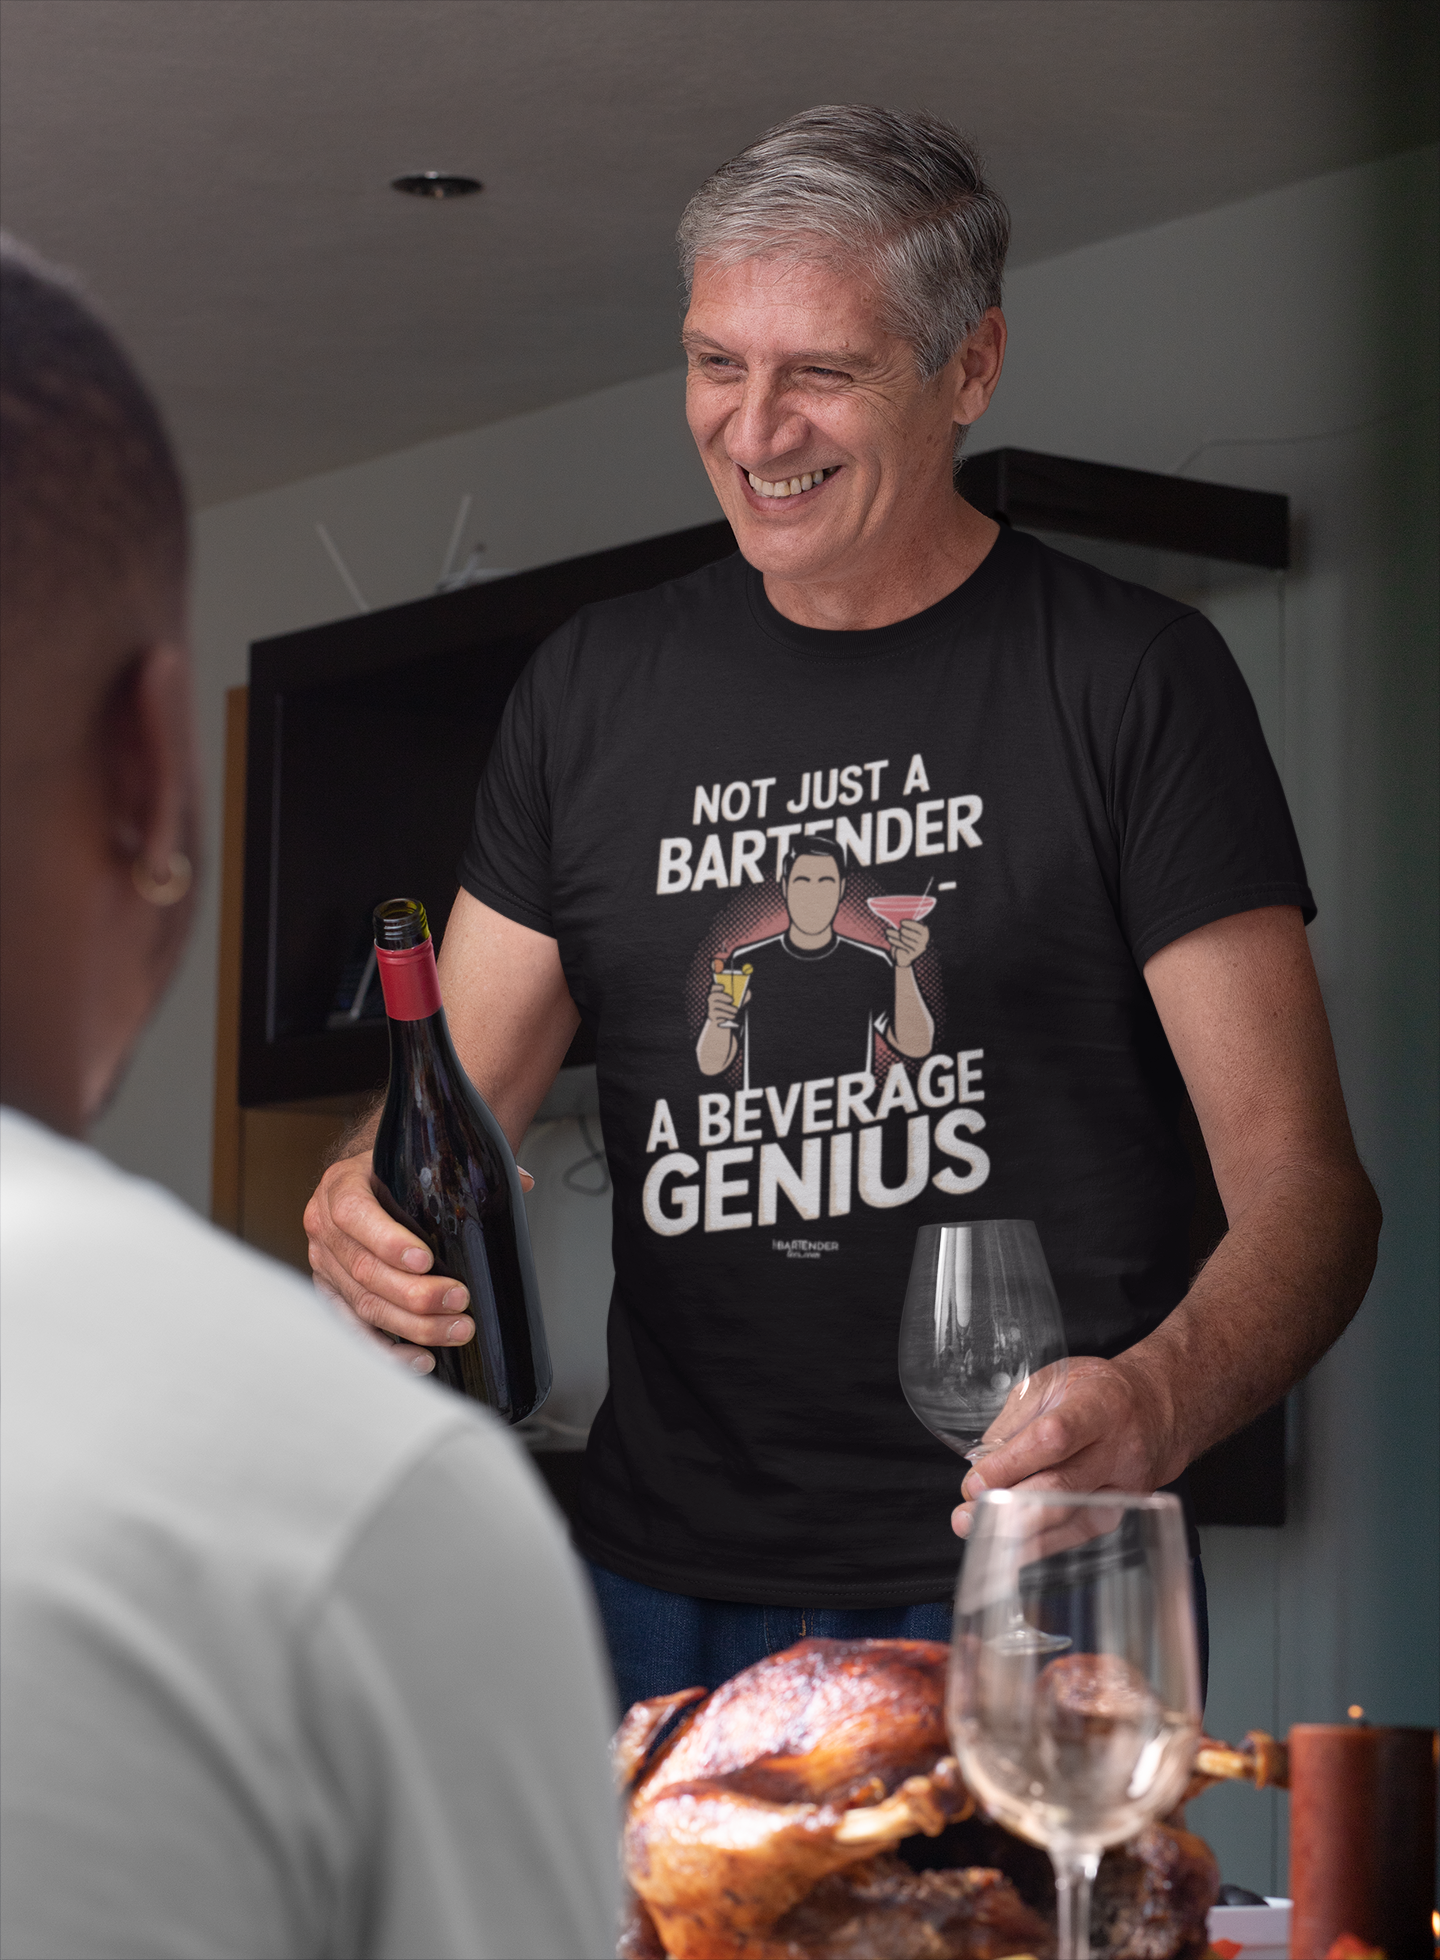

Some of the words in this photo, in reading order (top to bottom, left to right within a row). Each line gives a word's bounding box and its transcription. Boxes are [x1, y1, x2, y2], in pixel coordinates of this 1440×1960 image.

[692, 778, 777, 826] NOT
[786, 760, 889, 814] JUST
[903, 753, 931, 796] A
[646, 1099, 679, 1153] A
[698, 1048, 986, 1147] BEVERAGE
[642, 1108, 990, 1237] GENIUS
